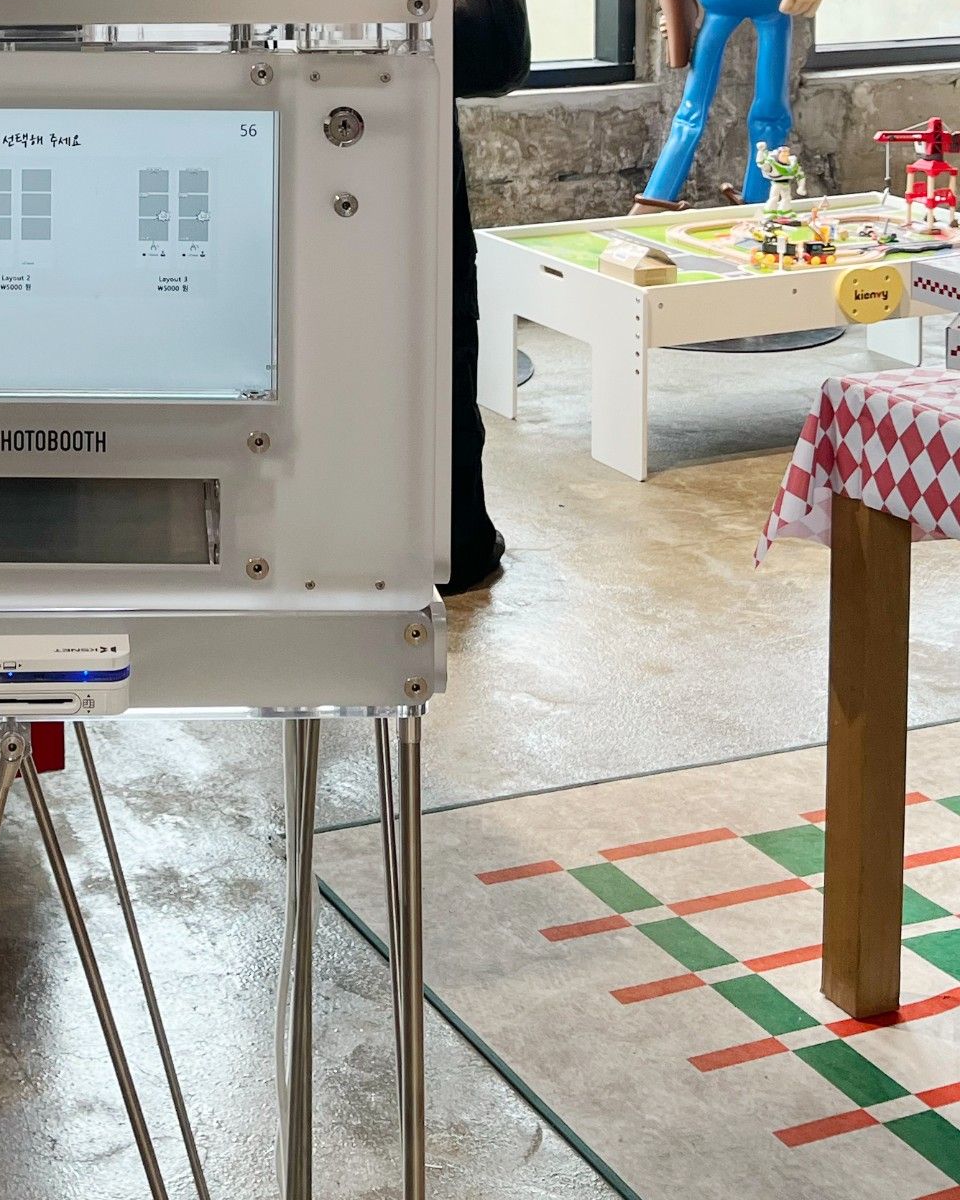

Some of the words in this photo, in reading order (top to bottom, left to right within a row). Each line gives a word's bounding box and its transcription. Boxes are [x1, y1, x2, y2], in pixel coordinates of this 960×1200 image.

[240, 123, 257, 137] 56
[2, 133, 43, 148] 선택해
[49, 133, 81, 147] 주세요
[1, 274, 24, 282] Layout
